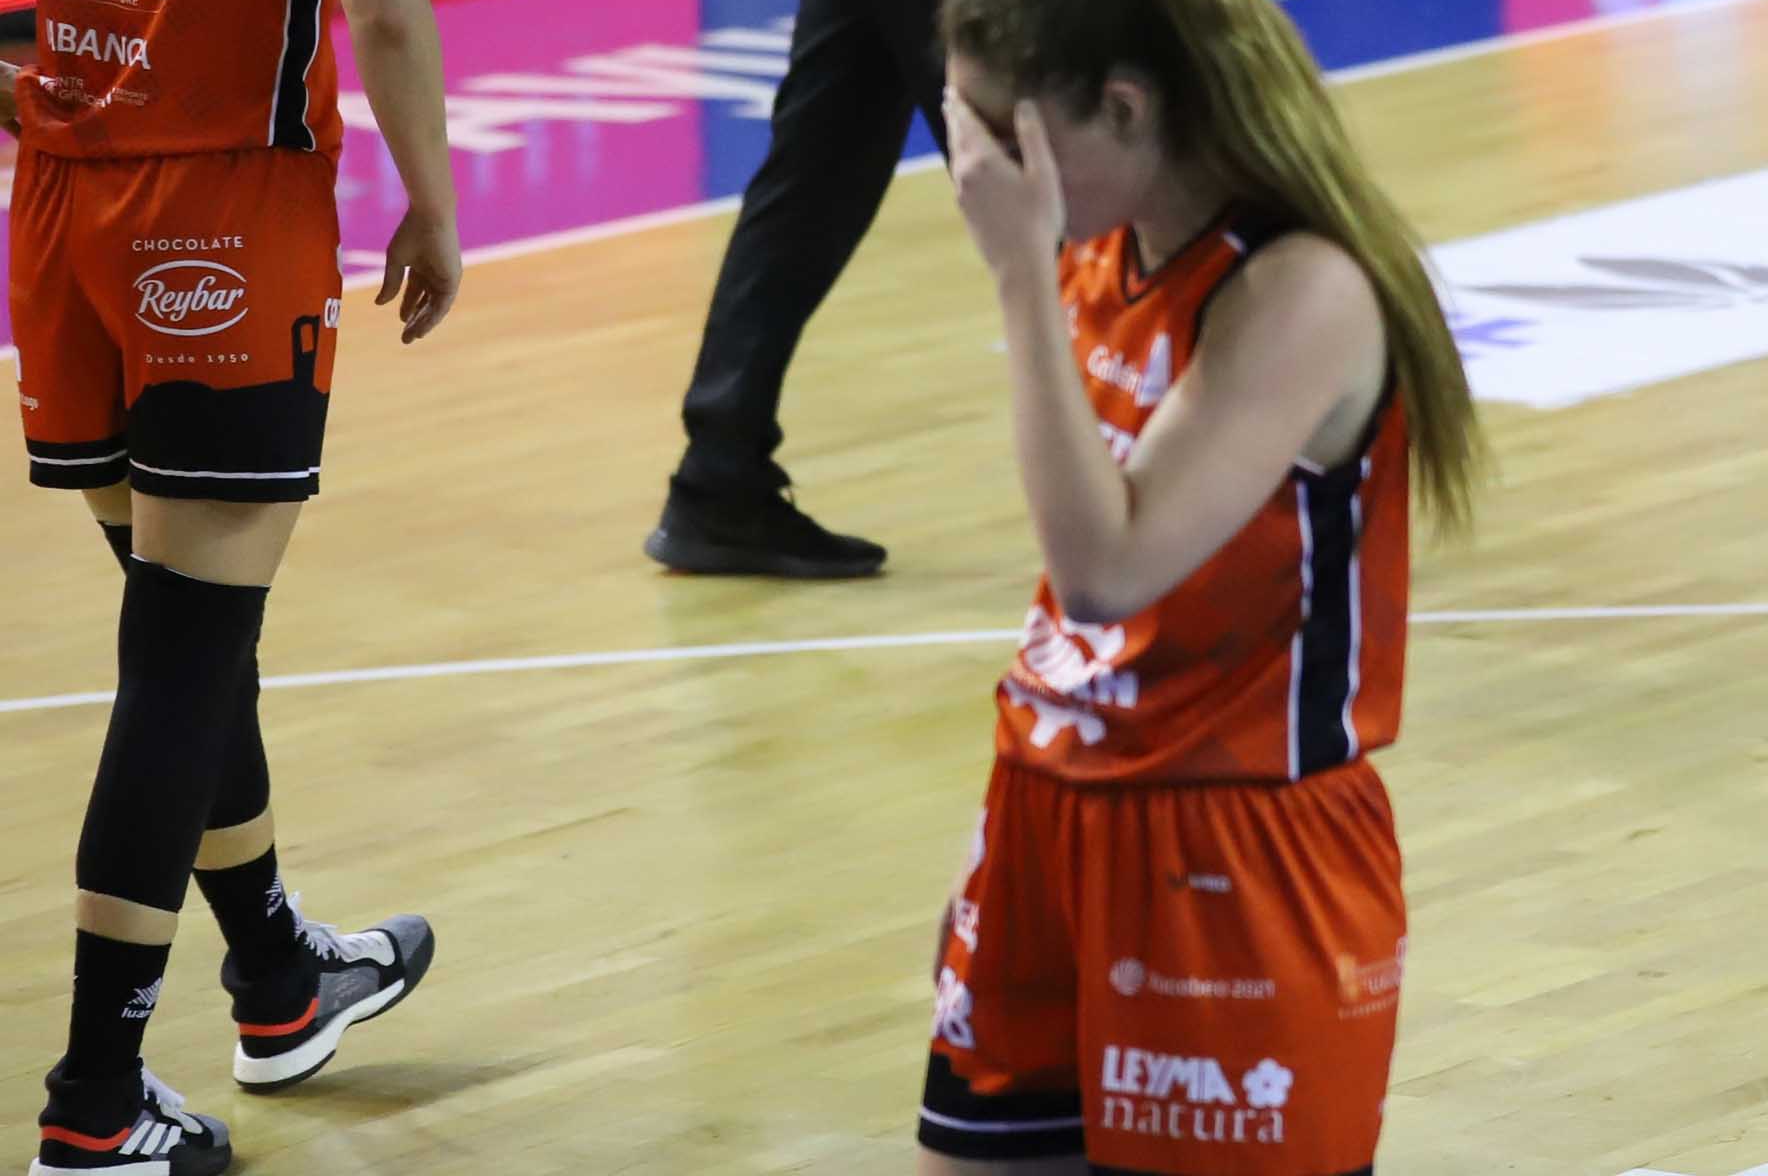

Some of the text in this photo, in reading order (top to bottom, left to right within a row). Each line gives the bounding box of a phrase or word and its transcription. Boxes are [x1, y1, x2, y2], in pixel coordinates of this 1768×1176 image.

[132, 235, 244, 252] CHOCOLATE
[136, 275, 245, 323] Reybar
[145, 353, 250, 365] Desde 1950
[1101, 1044, 1237, 1105] LEYMA
[1101, 1096, 1286, 1145] natura
